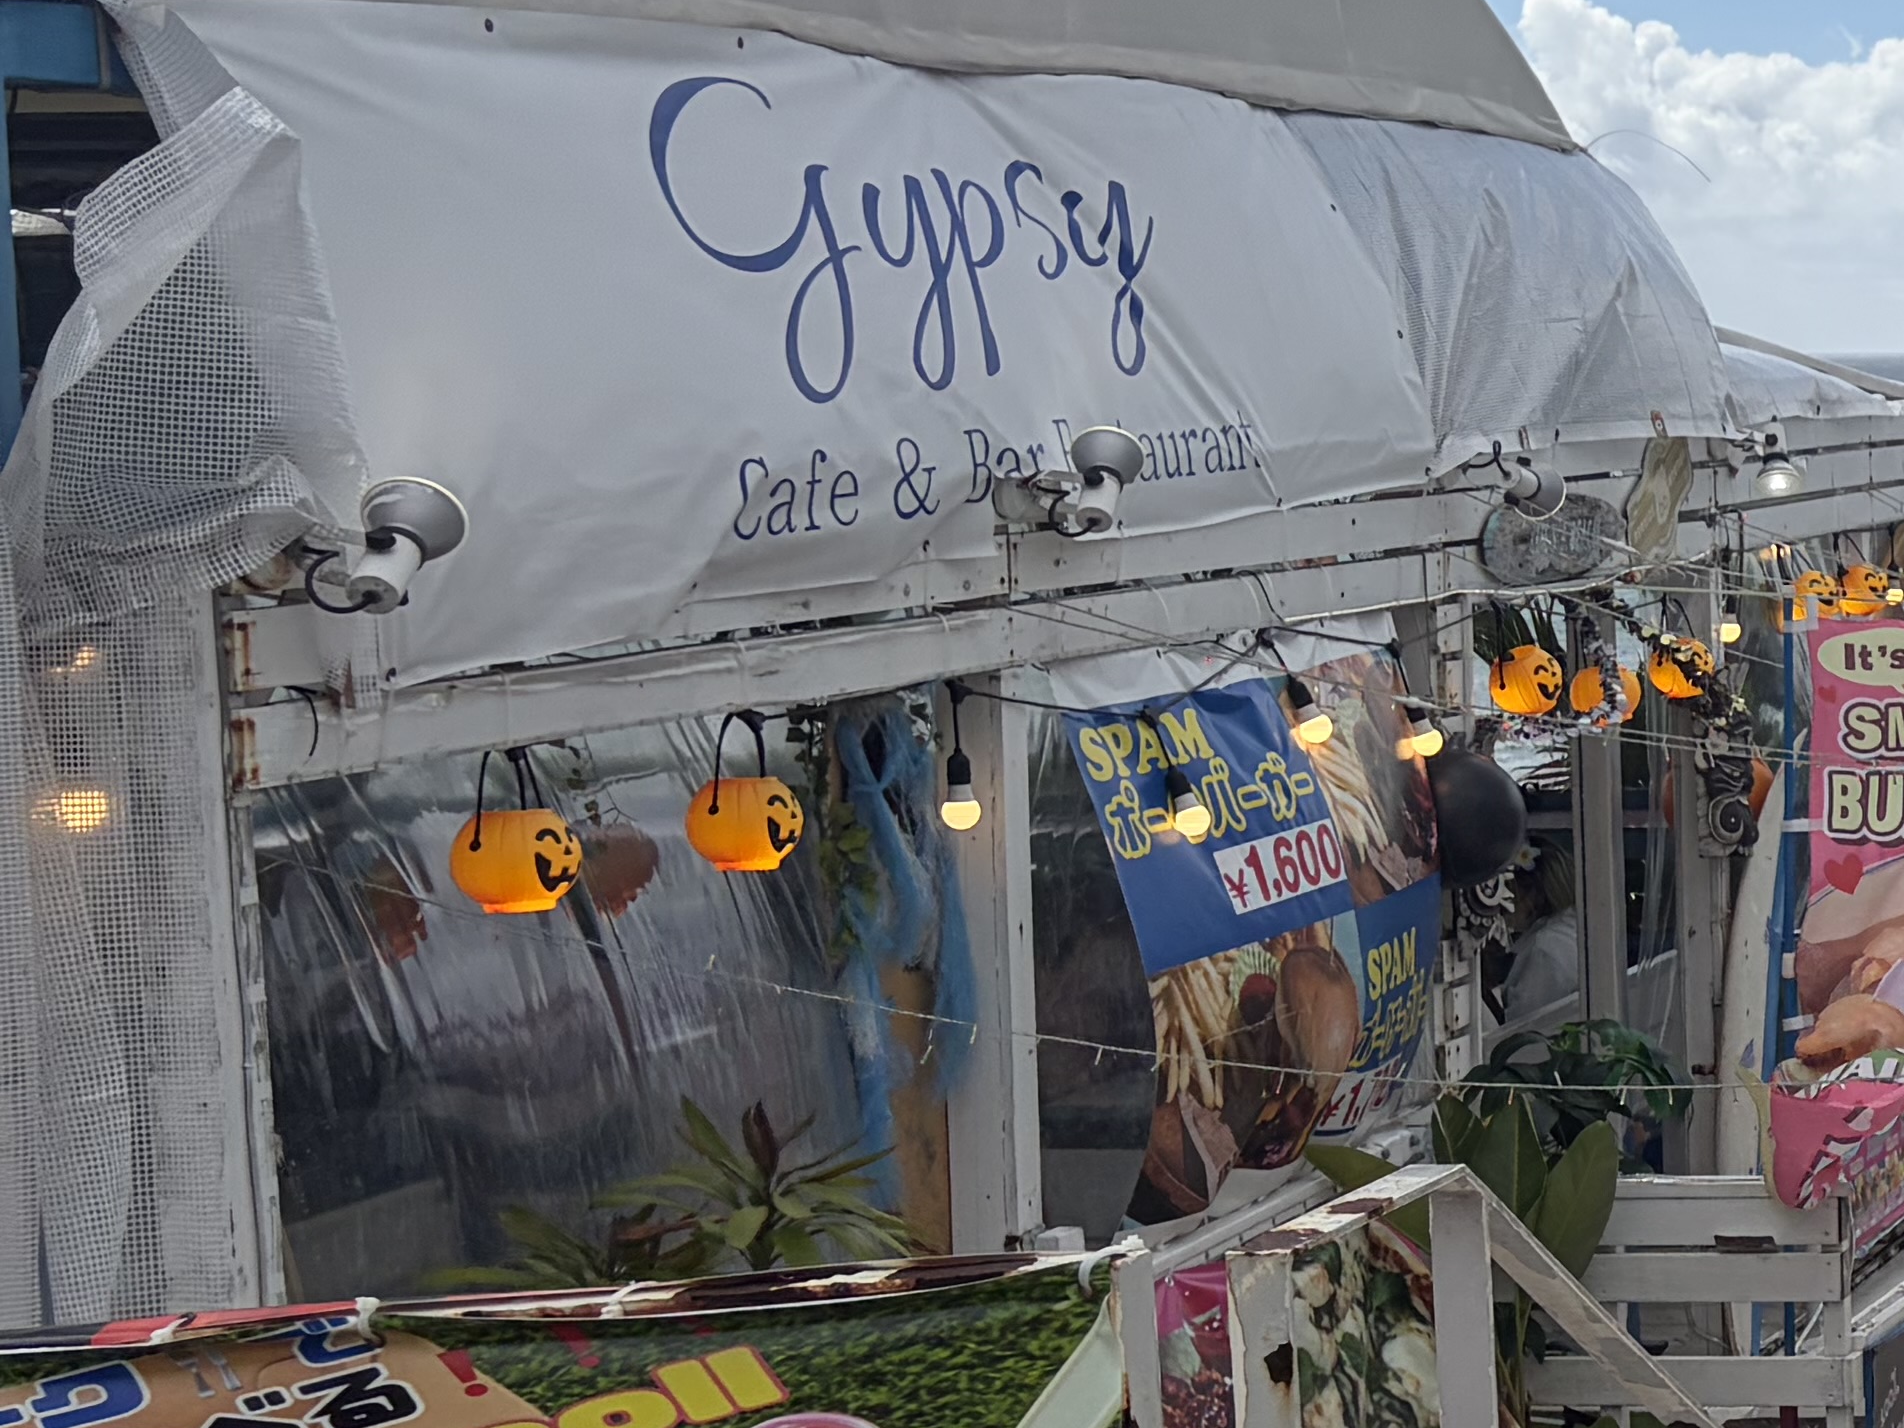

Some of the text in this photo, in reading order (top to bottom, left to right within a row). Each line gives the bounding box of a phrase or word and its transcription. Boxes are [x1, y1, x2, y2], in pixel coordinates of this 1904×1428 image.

[649, 76, 1154, 404] Gypsy
[733, 449, 860, 541] Cafe
[893, 437, 941, 520] &
[1079, 708, 1215, 782] SPAM
[1105, 752, 1315, 860] ポーバーガー
[1223, 822, 1342, 909] ¥1,600
[1367, 927, 1417, 1002] SPAM
